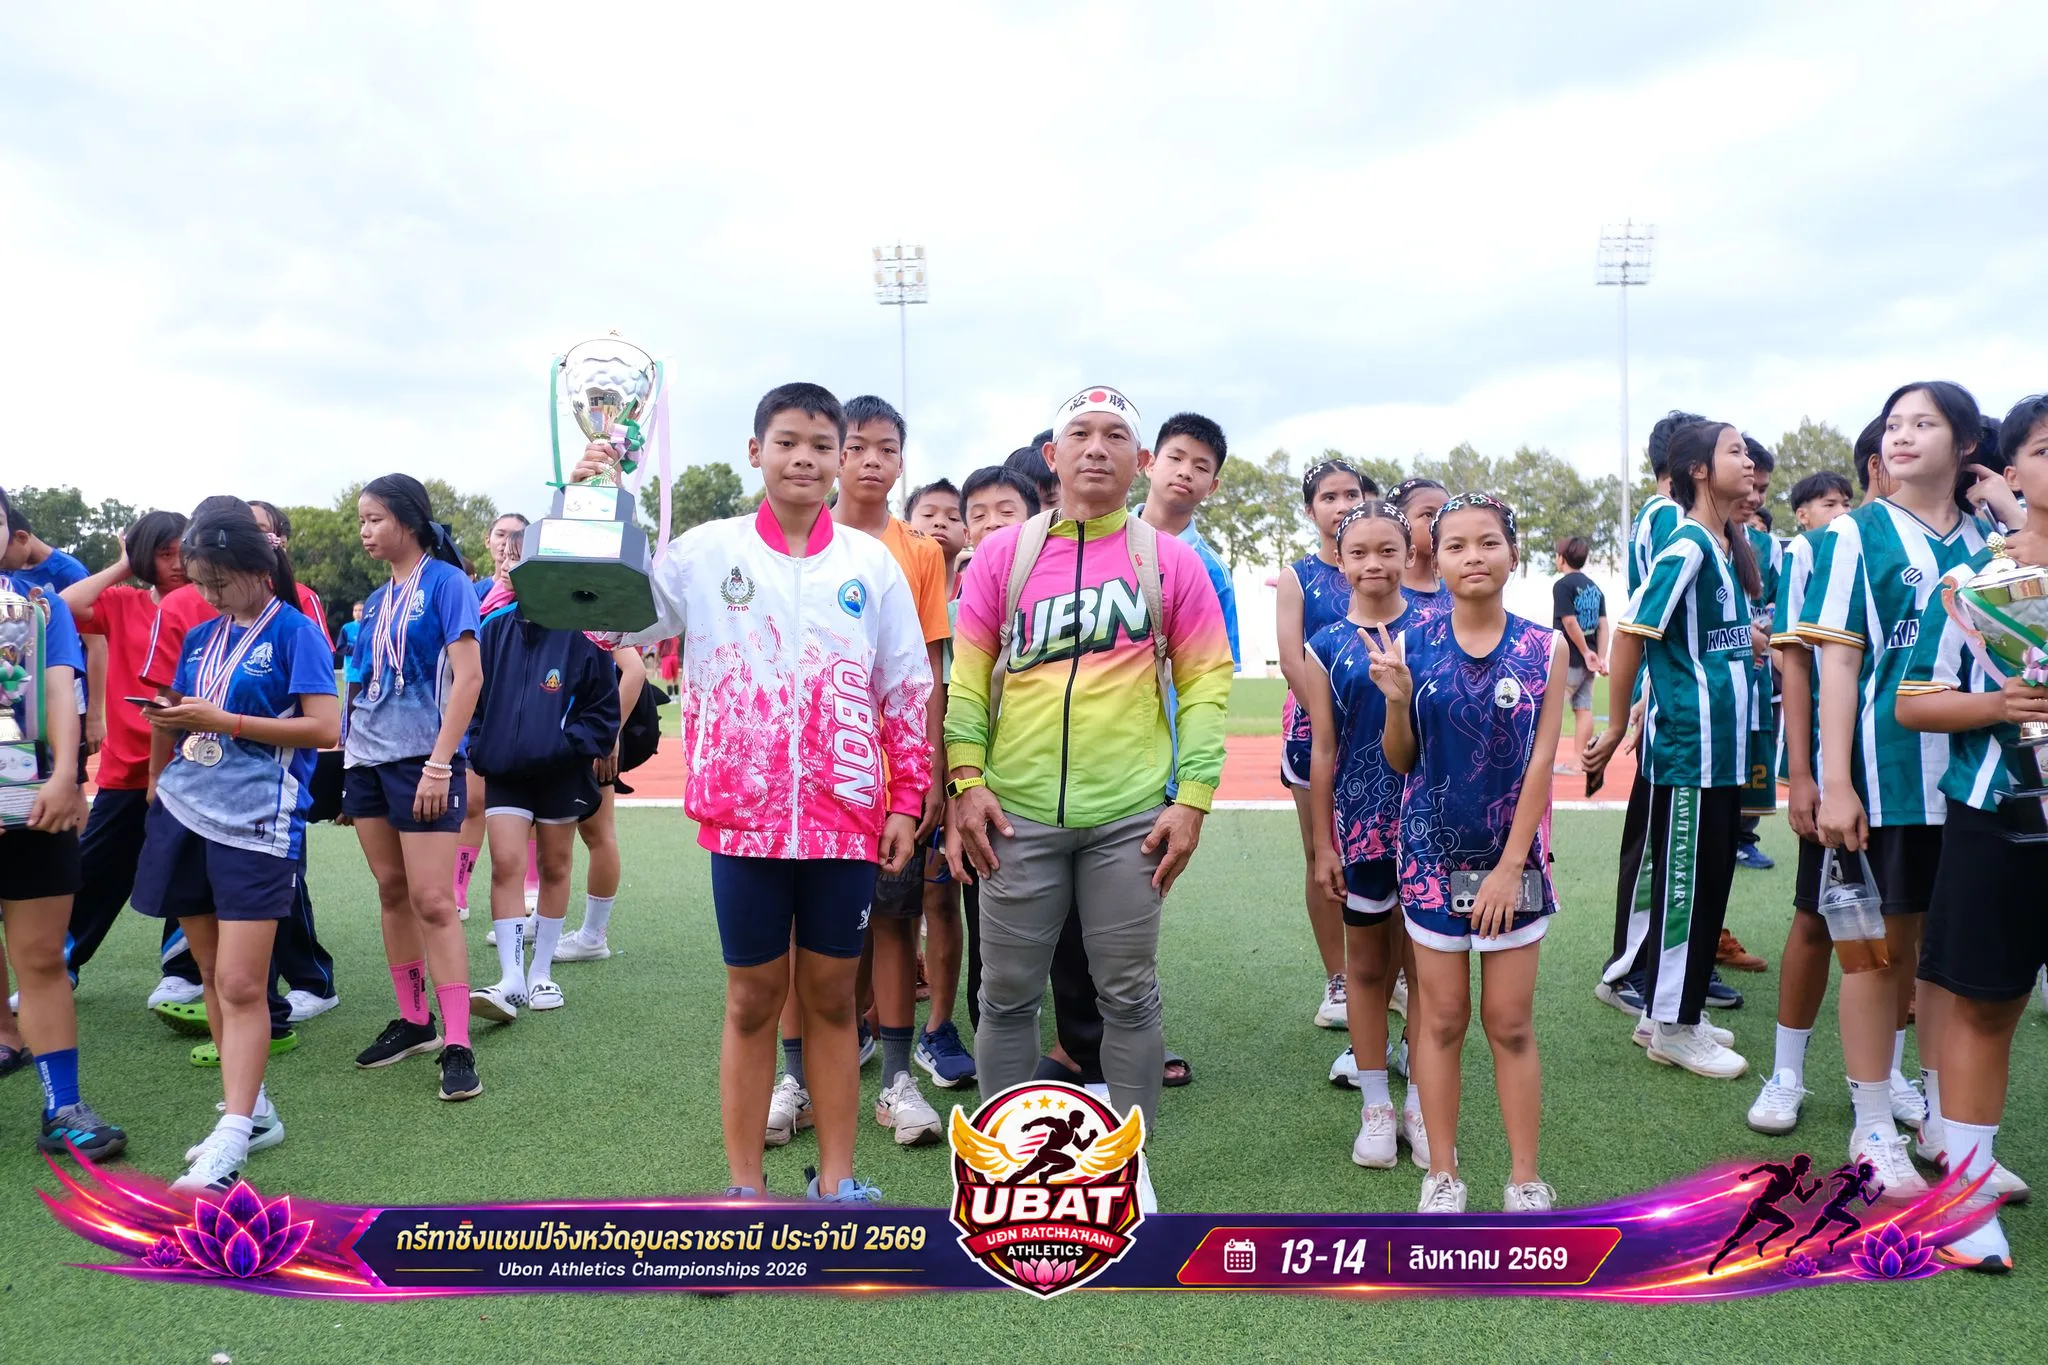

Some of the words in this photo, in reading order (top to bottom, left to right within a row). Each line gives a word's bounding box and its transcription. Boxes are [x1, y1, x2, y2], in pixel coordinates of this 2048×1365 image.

[1007, 574, 1164, 674] UBN
[1885, 618, 1920, 649] KA
[831, 659, 878, 809] UBON
